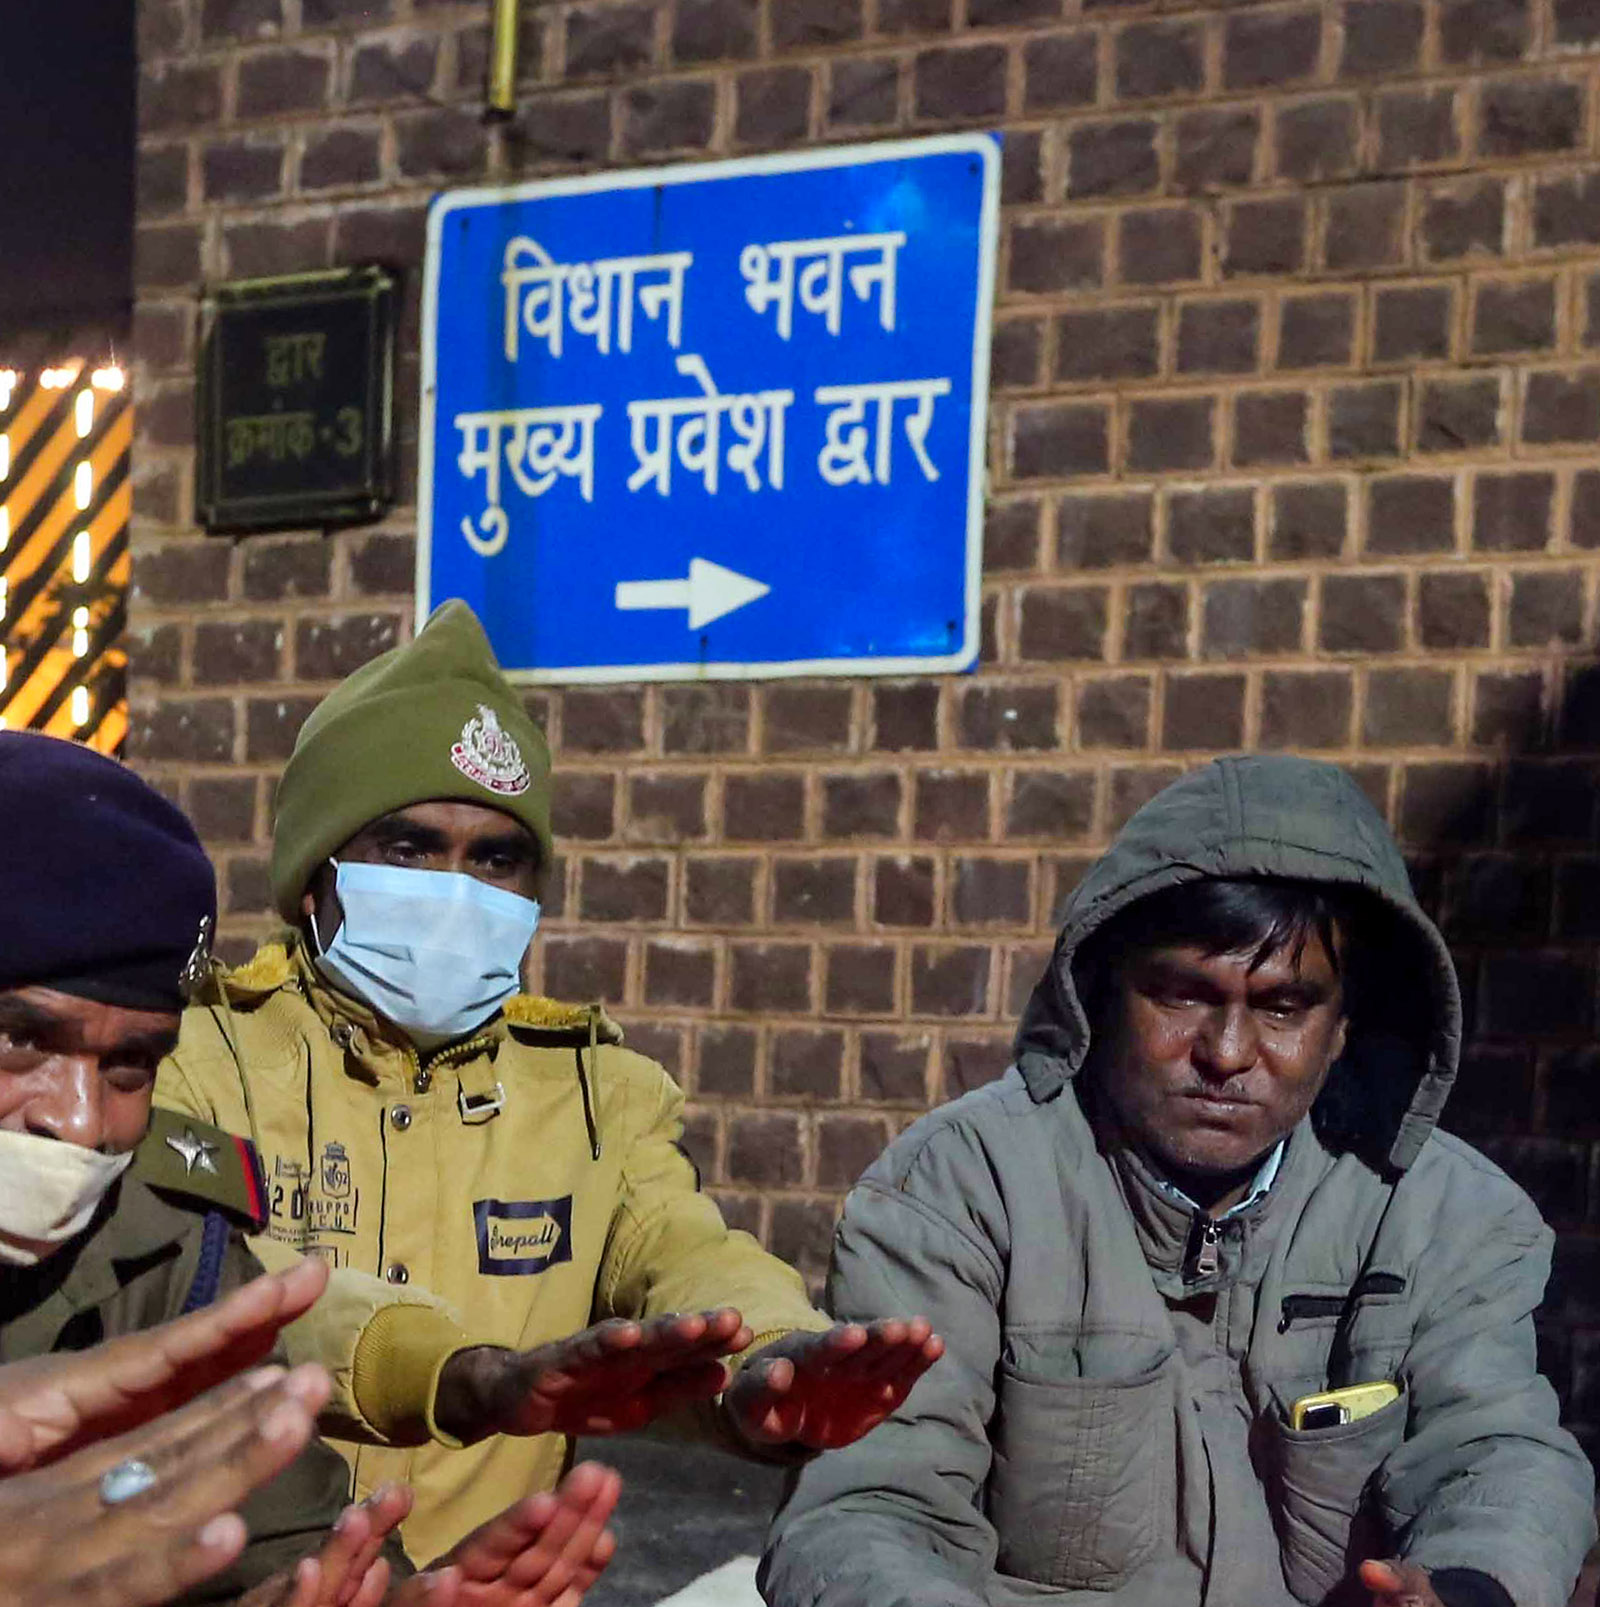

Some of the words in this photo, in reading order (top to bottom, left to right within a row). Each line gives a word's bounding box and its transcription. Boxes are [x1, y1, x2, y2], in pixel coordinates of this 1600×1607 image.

[502, 236, 693, 362] विधान
[739, 231, 907, 341] भवन
[454, 403, 603, 556] मुख्य
[626, 353, 794, 497] प्रवेश
[815, 377, 952, 484] द्वार
